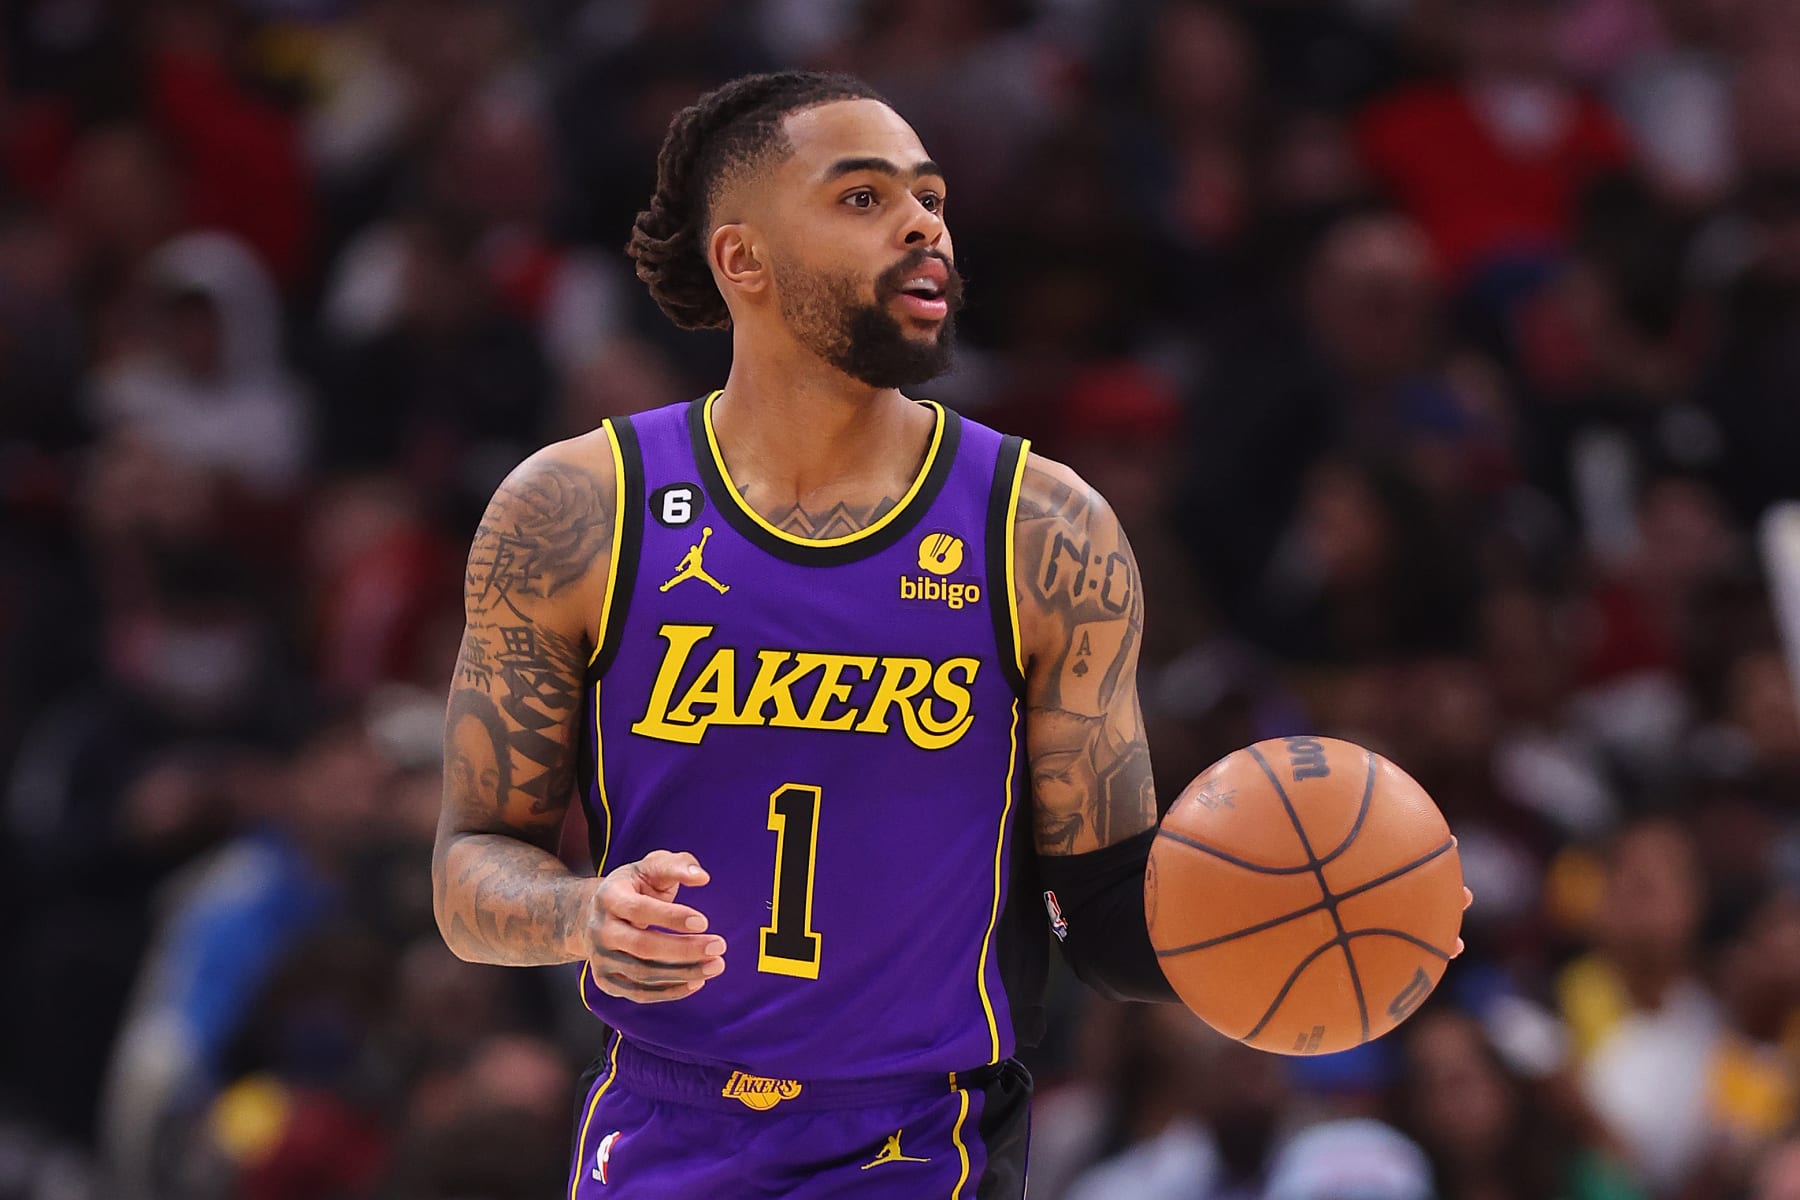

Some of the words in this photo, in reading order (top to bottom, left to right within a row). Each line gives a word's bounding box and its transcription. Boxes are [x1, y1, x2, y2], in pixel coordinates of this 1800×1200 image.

[662, 488, 693, 524] 6
[900, 575, 981, 610] bibigo
[1076, 630, 1092, 656] A
[630, 623, 982, 751] LAKERS
[1282, 736, 1330, 781] on
[757, 782, 823, 980] 1
[723, 1071, 802, 1099] LAKERS
